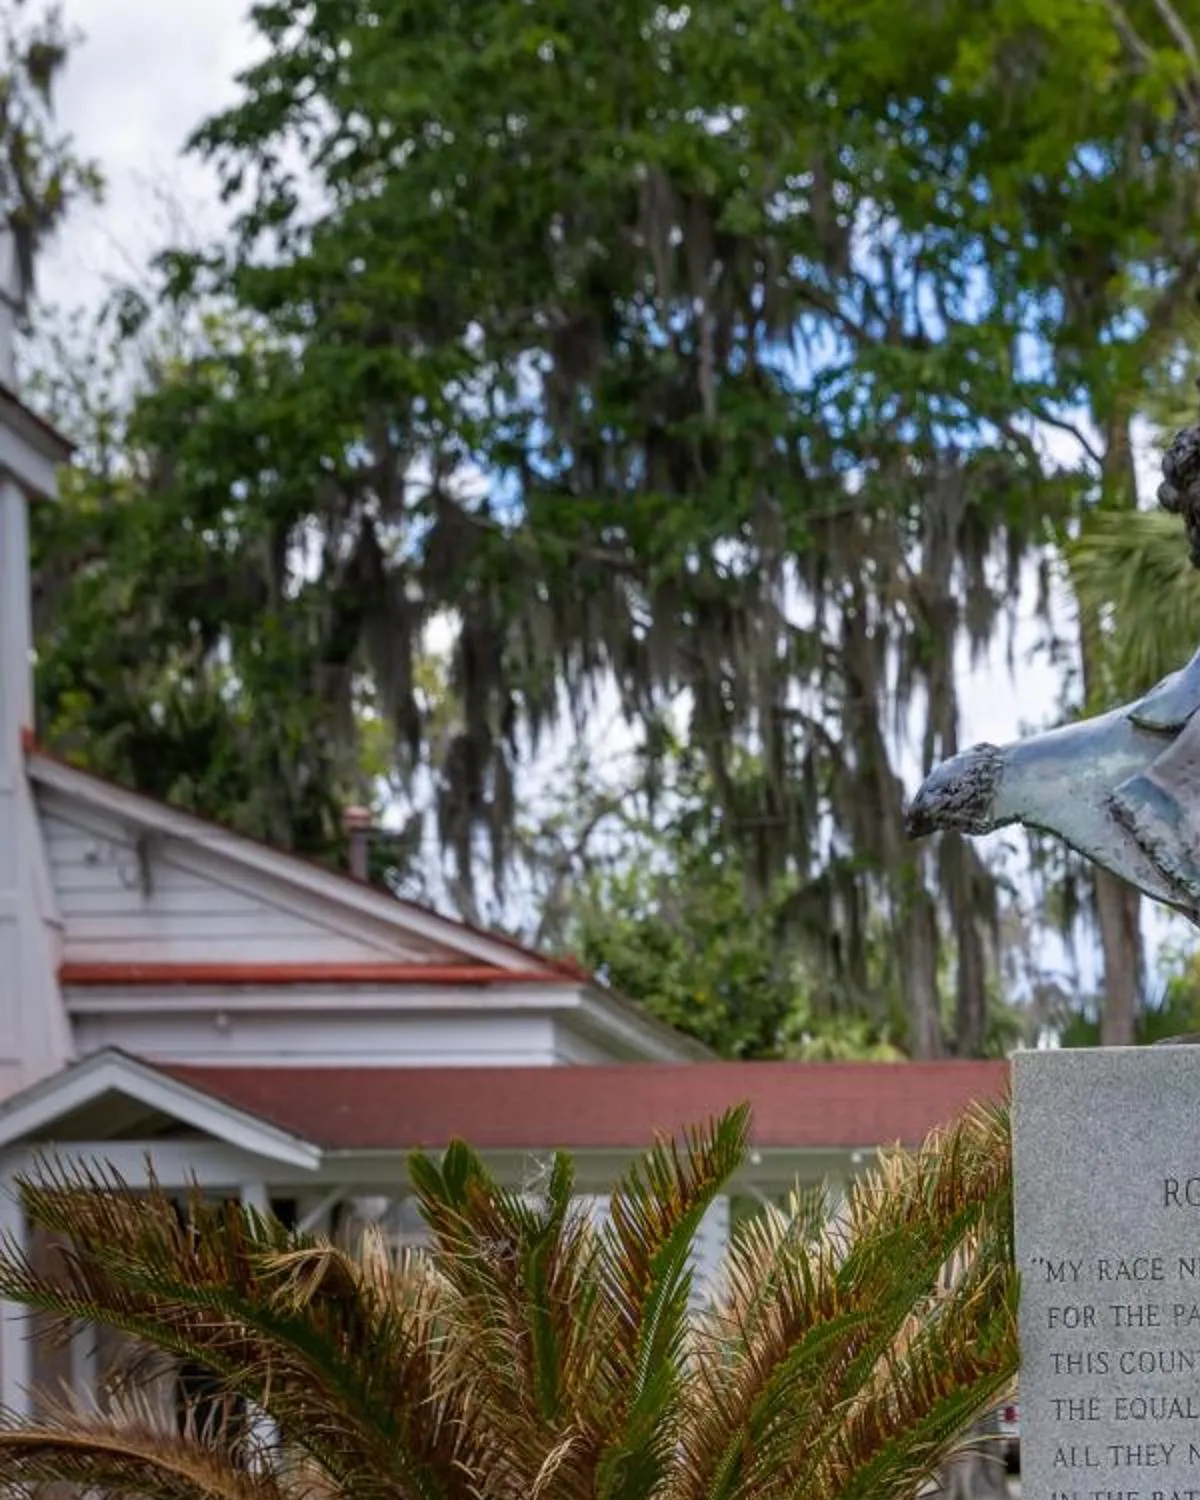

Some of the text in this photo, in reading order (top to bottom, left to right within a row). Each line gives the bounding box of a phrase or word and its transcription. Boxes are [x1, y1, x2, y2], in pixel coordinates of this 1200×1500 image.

[1099, 1256, 1165, 1281] RACE
[1047, 1304, 1097, 1329] FOR
[1109, 1304, 1161, 1328] THE
[1050, 1351, 1109, 1375] THIS
[1052, 1398, 1101, 1421] THE
[1115, 1396, 1200, 1421] EQUAL
[1052, 1446, 1100, 1468] ALL
[1107, 1443, 1177, 1468] THEY
